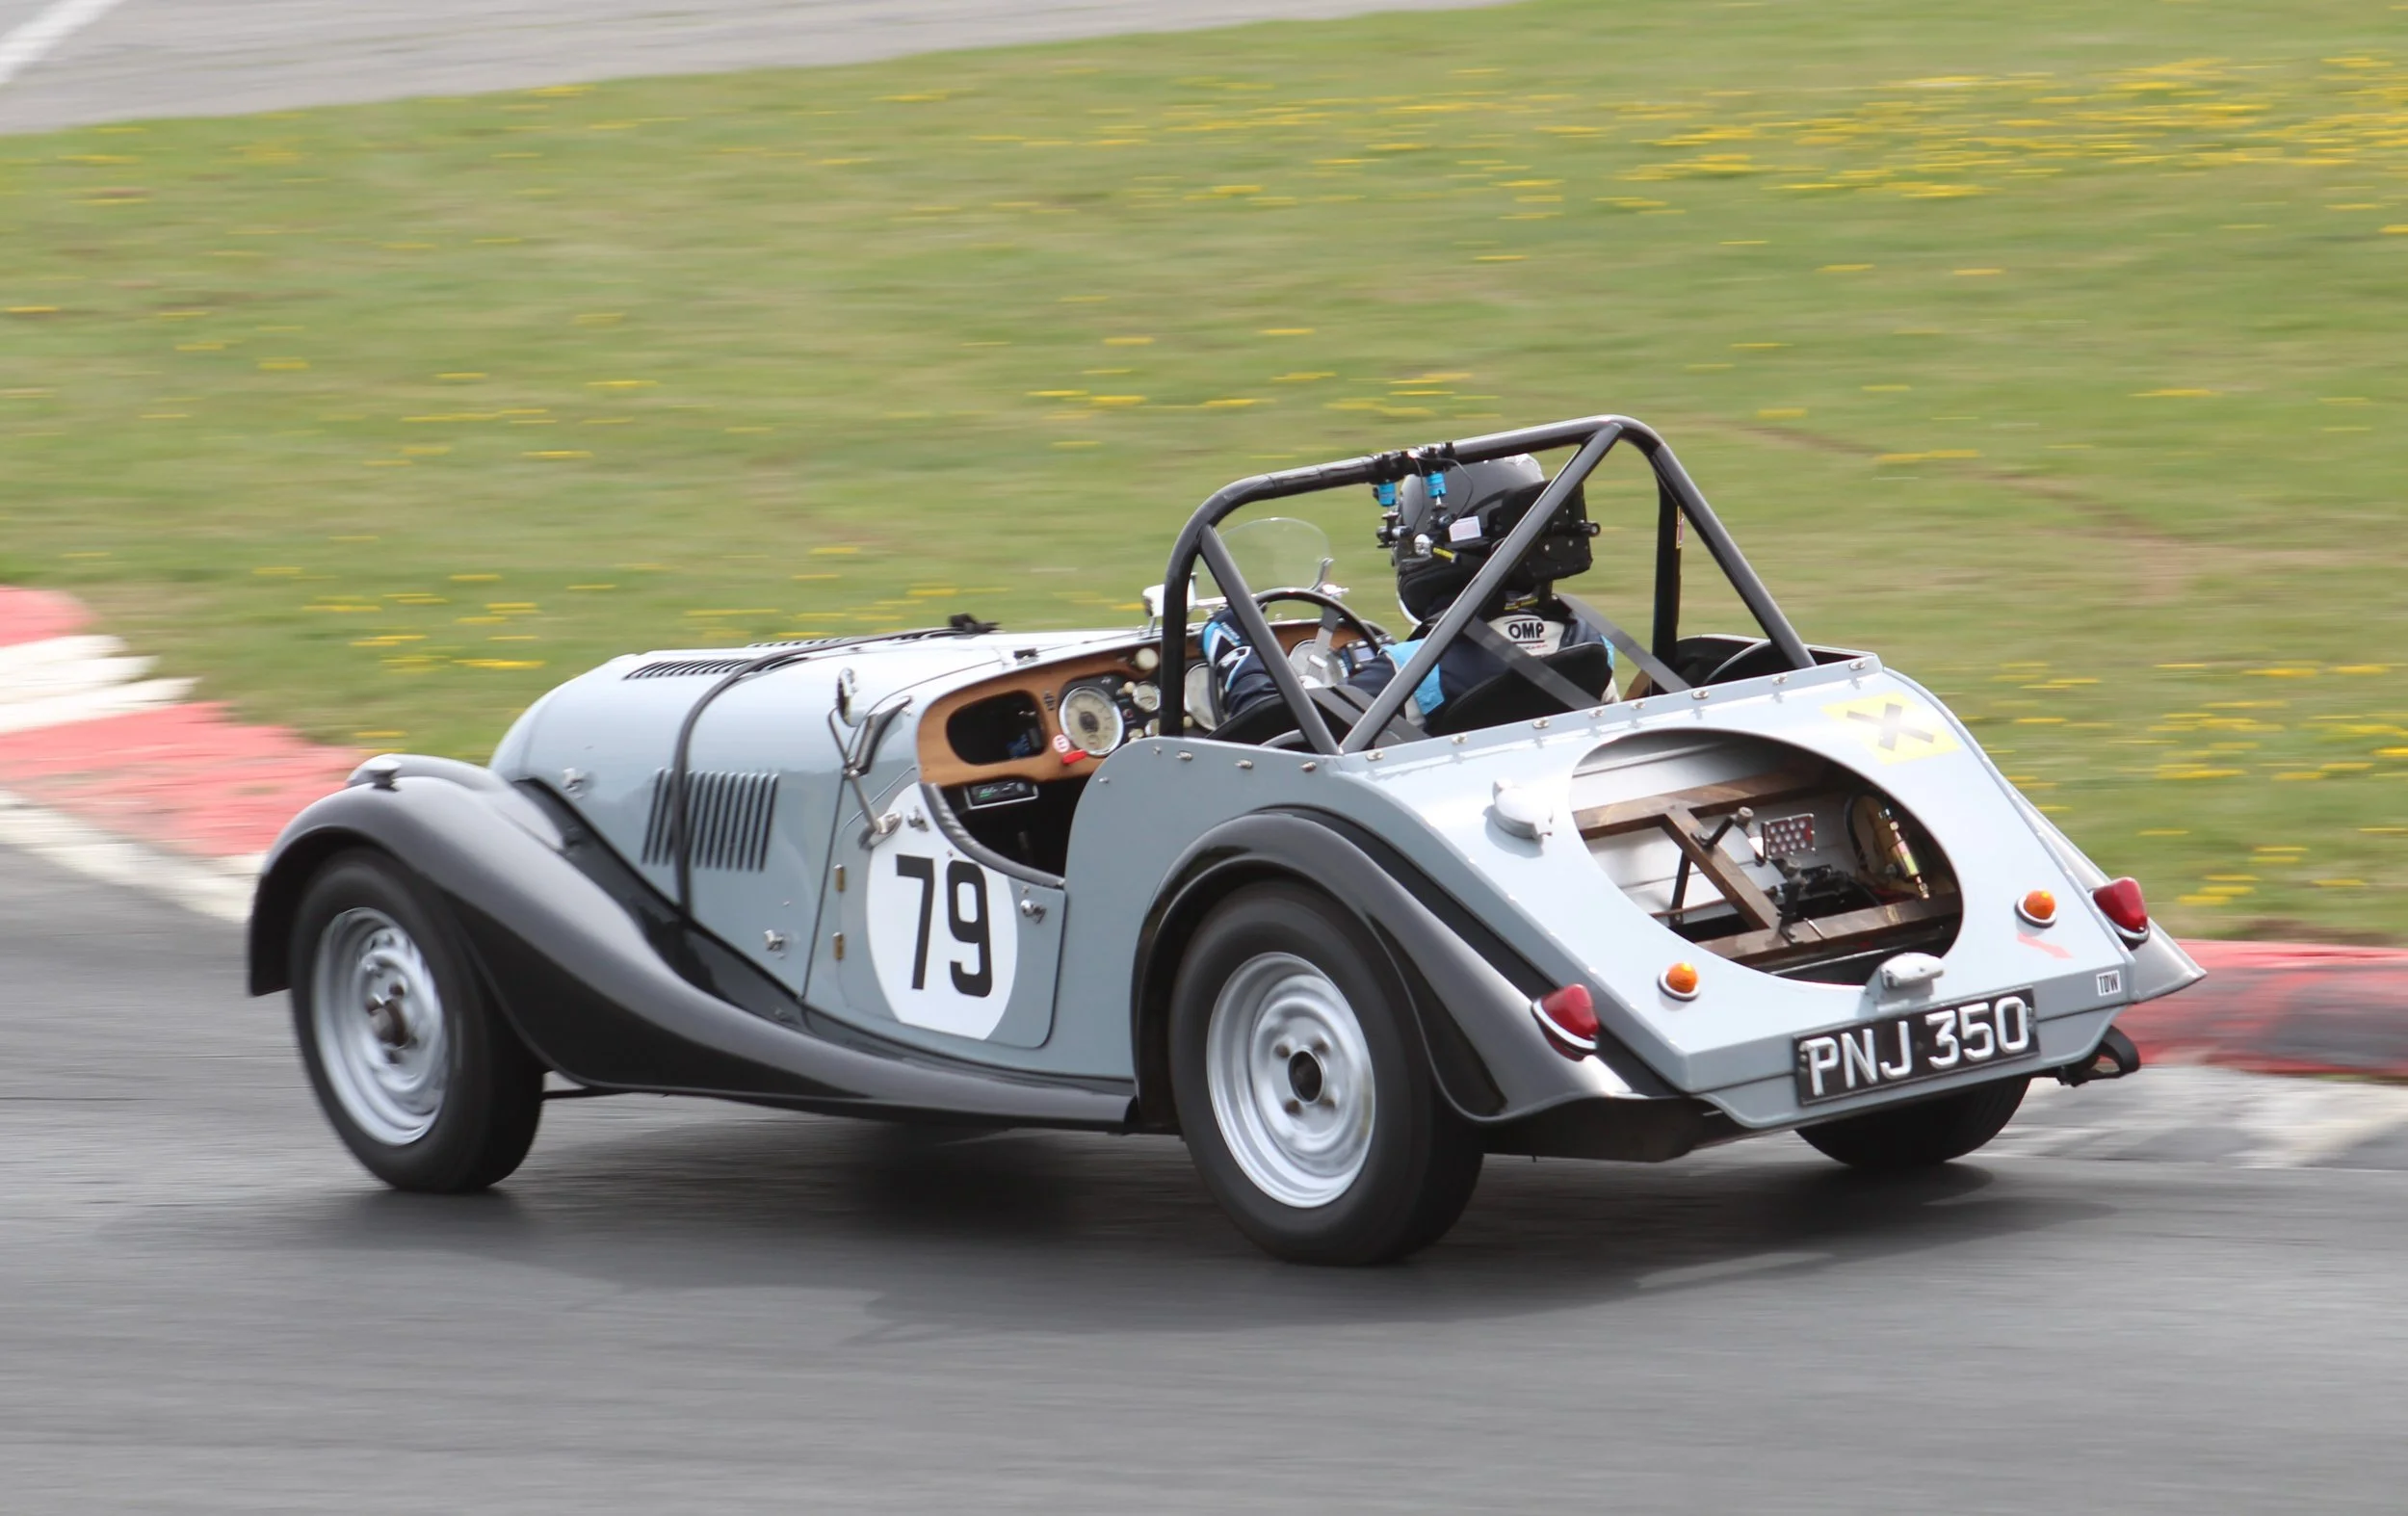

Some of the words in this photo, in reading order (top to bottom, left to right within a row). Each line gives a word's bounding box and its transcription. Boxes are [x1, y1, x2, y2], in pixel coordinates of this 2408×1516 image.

[1508, 622, 1544, 640] OMP
[896, 854, 993, 998] 79
[1800, 1020, 1913, 1096] PNJ
[1926, 996, 2029, 1070] 350
